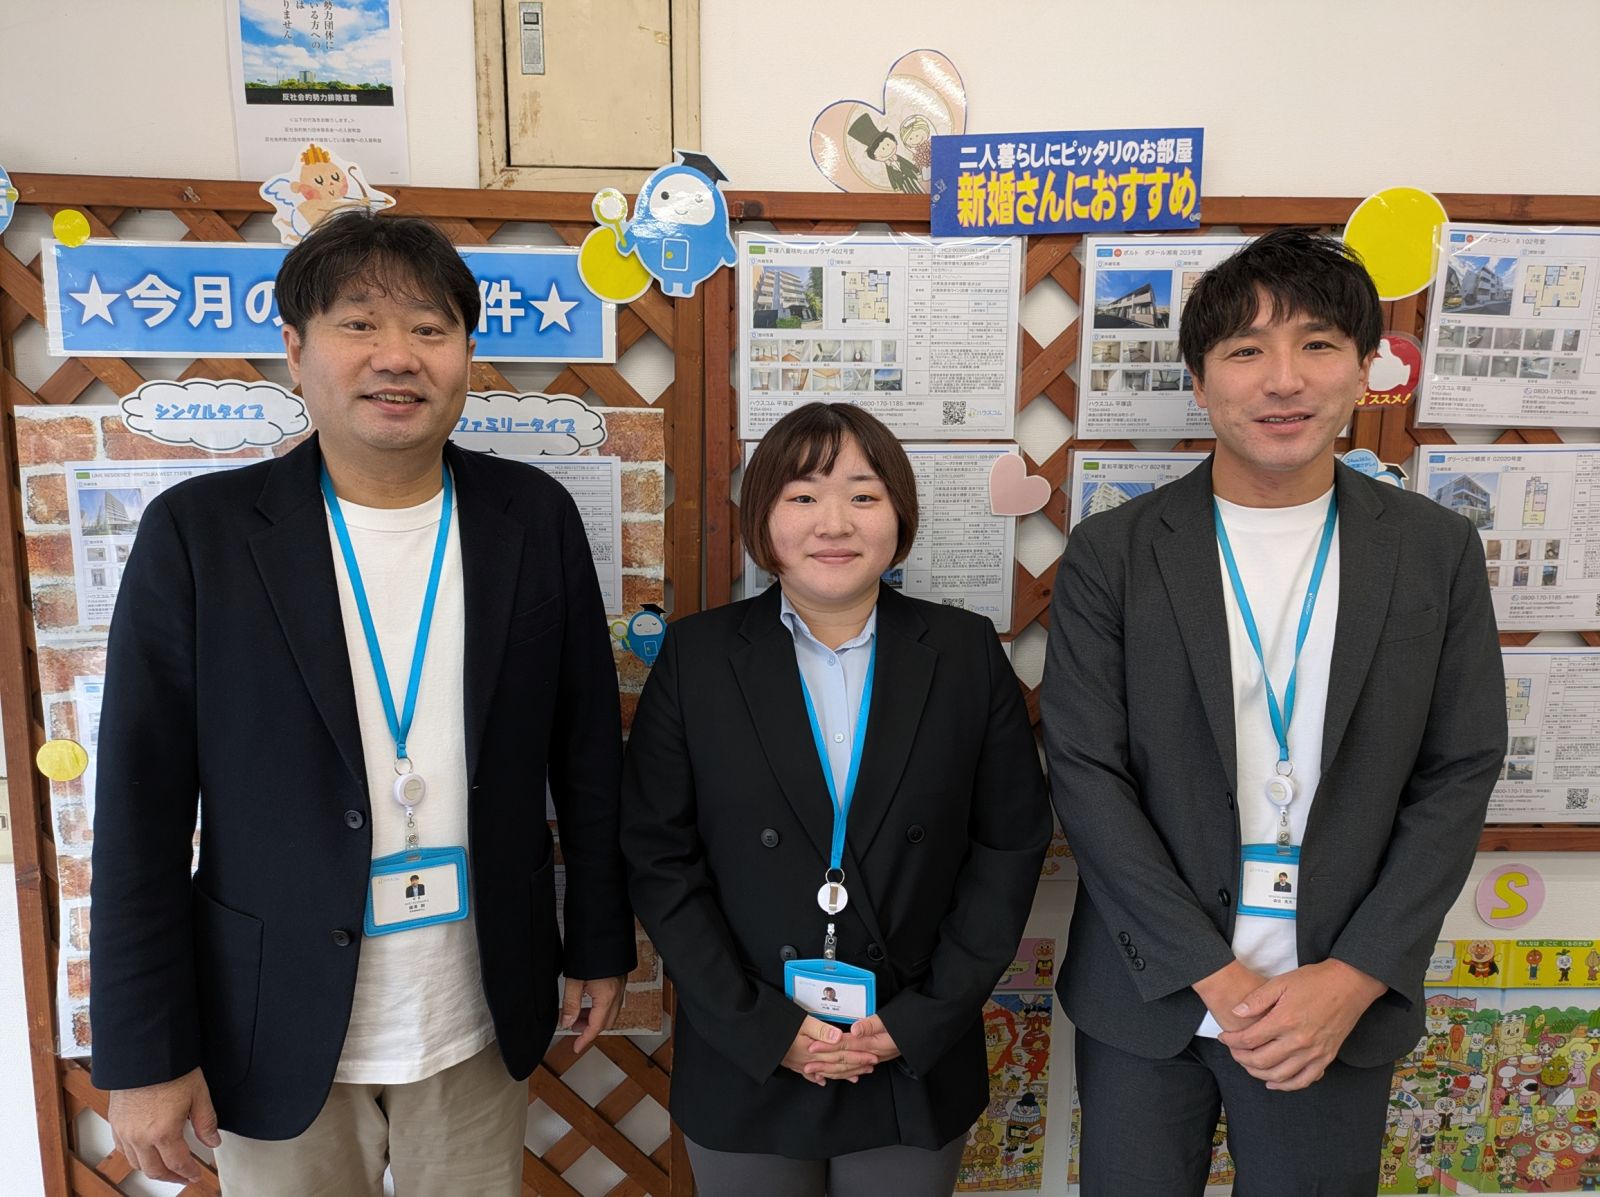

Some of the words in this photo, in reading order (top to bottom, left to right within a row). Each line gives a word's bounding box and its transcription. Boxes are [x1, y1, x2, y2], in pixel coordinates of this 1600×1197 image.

[282, 93, 358, 103] 反社会的勢力排除宣言
[959, 138, 1193, 169] 二人暮らしにピッタリのお部屋
[957, 166, 1197, 228] 新婚さんにおすすめ
[125, 273, 283, 329] 今月の
[154, 403, 265, 419] シングルタイプ
[459, 417, 576, 432] ファミリータイプ
[1490, 871, 1530, 920] S
